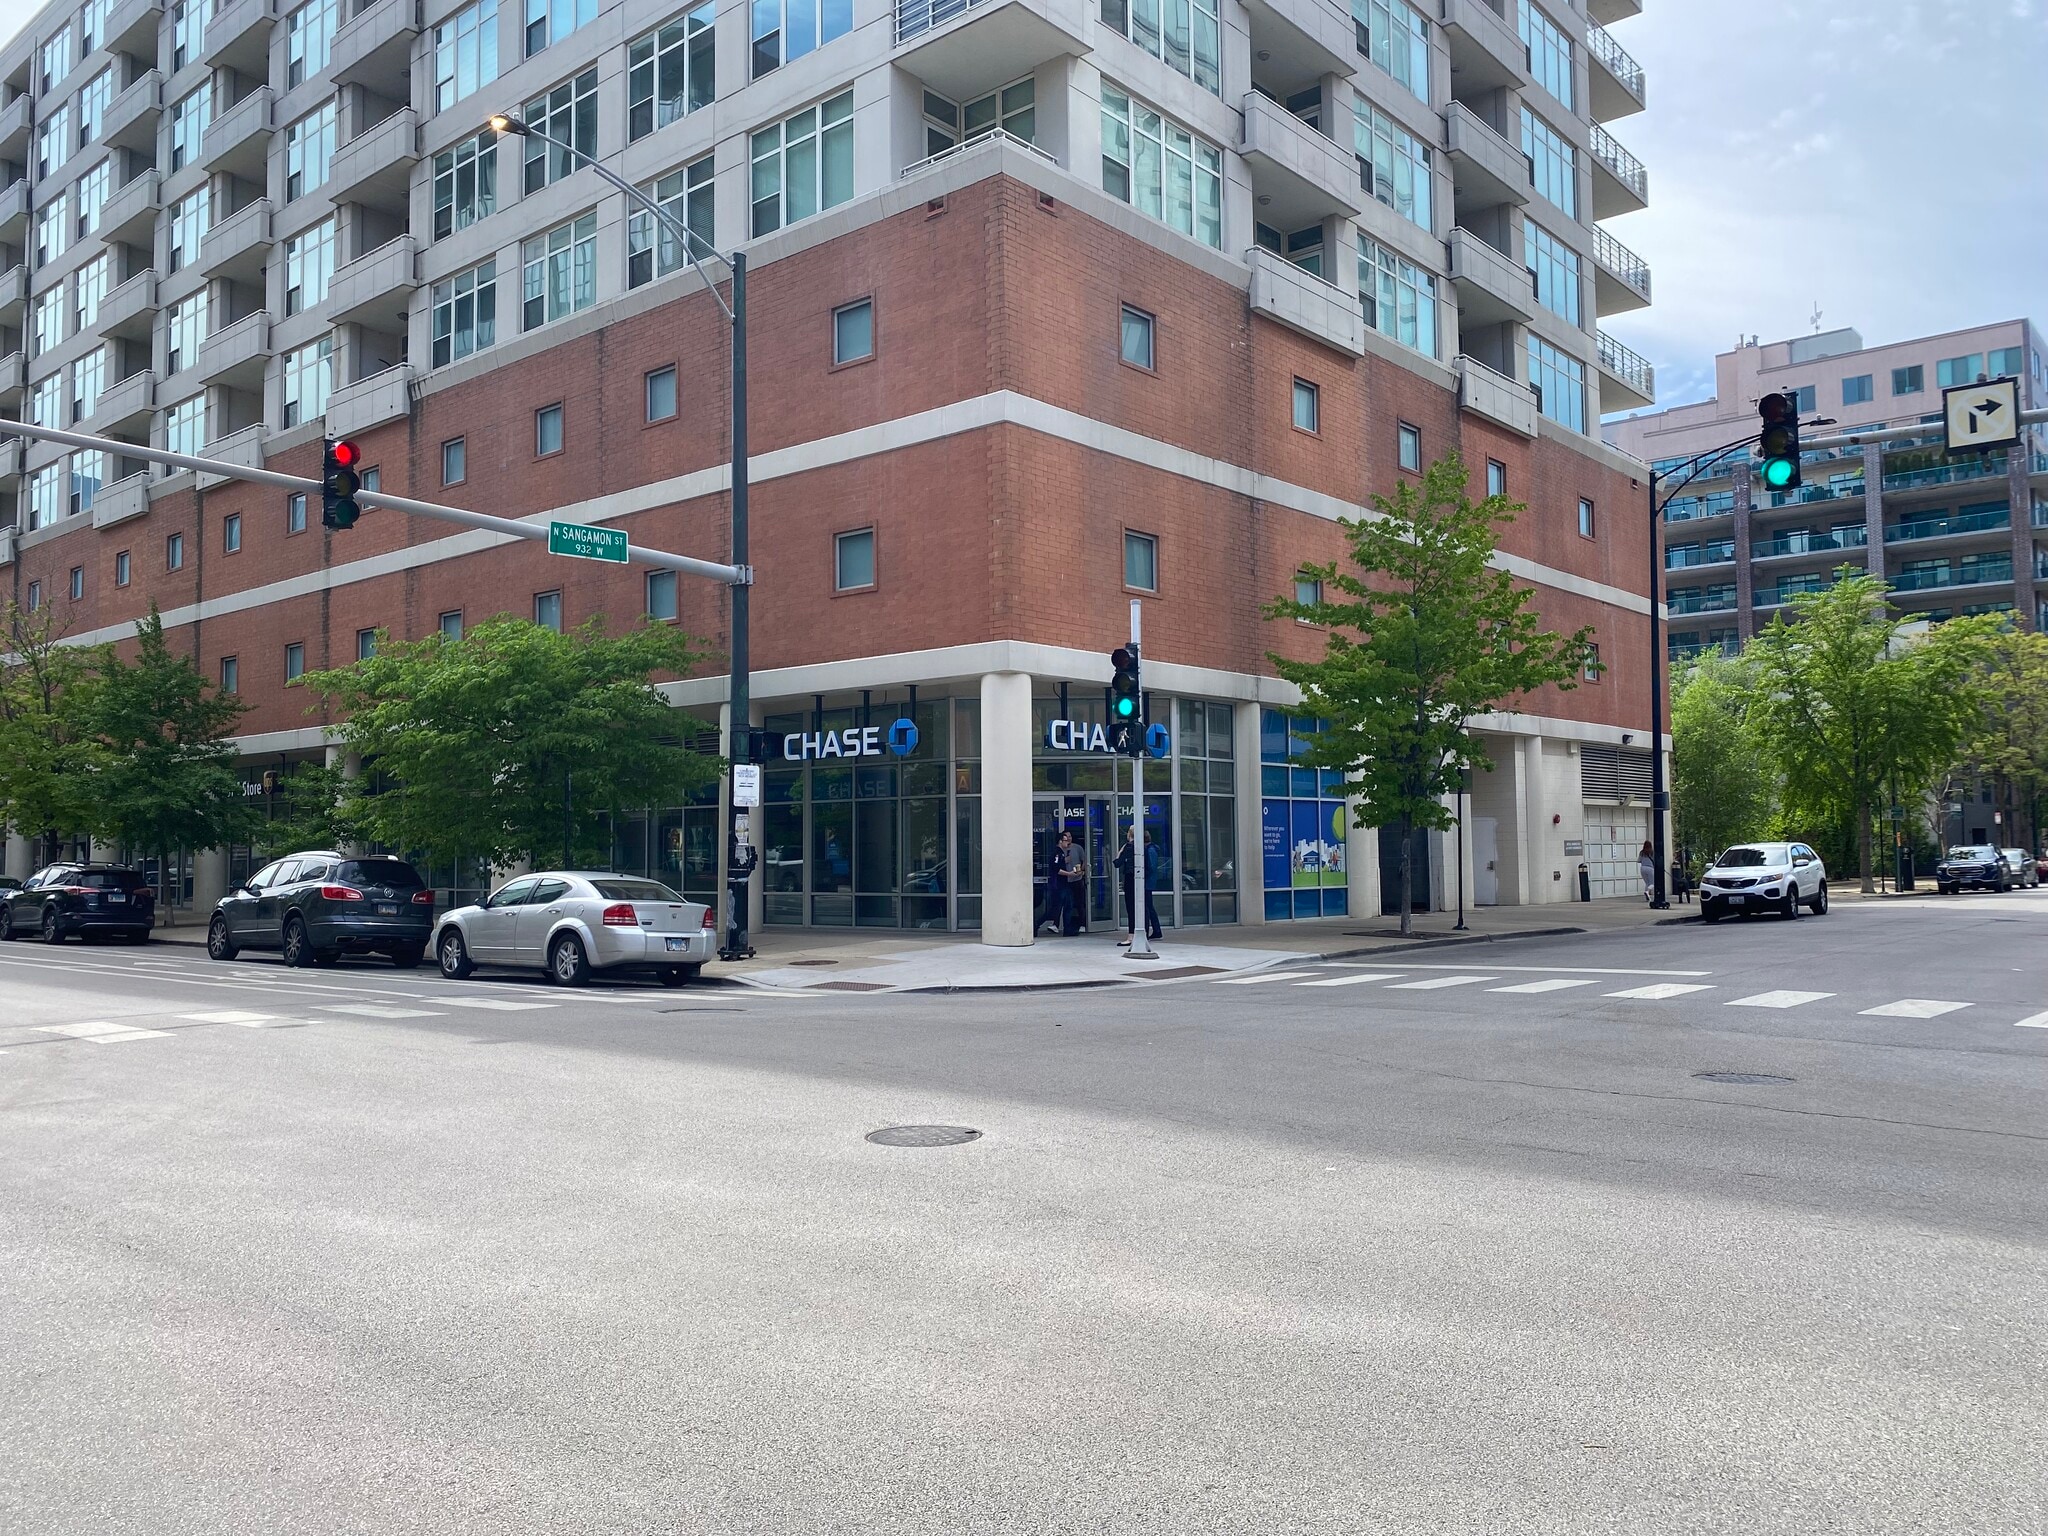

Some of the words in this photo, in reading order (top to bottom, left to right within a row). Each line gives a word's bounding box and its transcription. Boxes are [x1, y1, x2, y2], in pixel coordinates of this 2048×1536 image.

[554, 527, 559, 536] N
[562, 526, 612, 546] SANGAMON
[614, 536, 623, 546] ST
[576, 544, 592, 554] 932
[596, 546, 604, 556] W
[784, 726, 882, 760] CHASE
[1050, 720, 1116, 752] CHA
[242, 781, 262, 796] Store
[1117, 806, 1150, 816] CHAE
